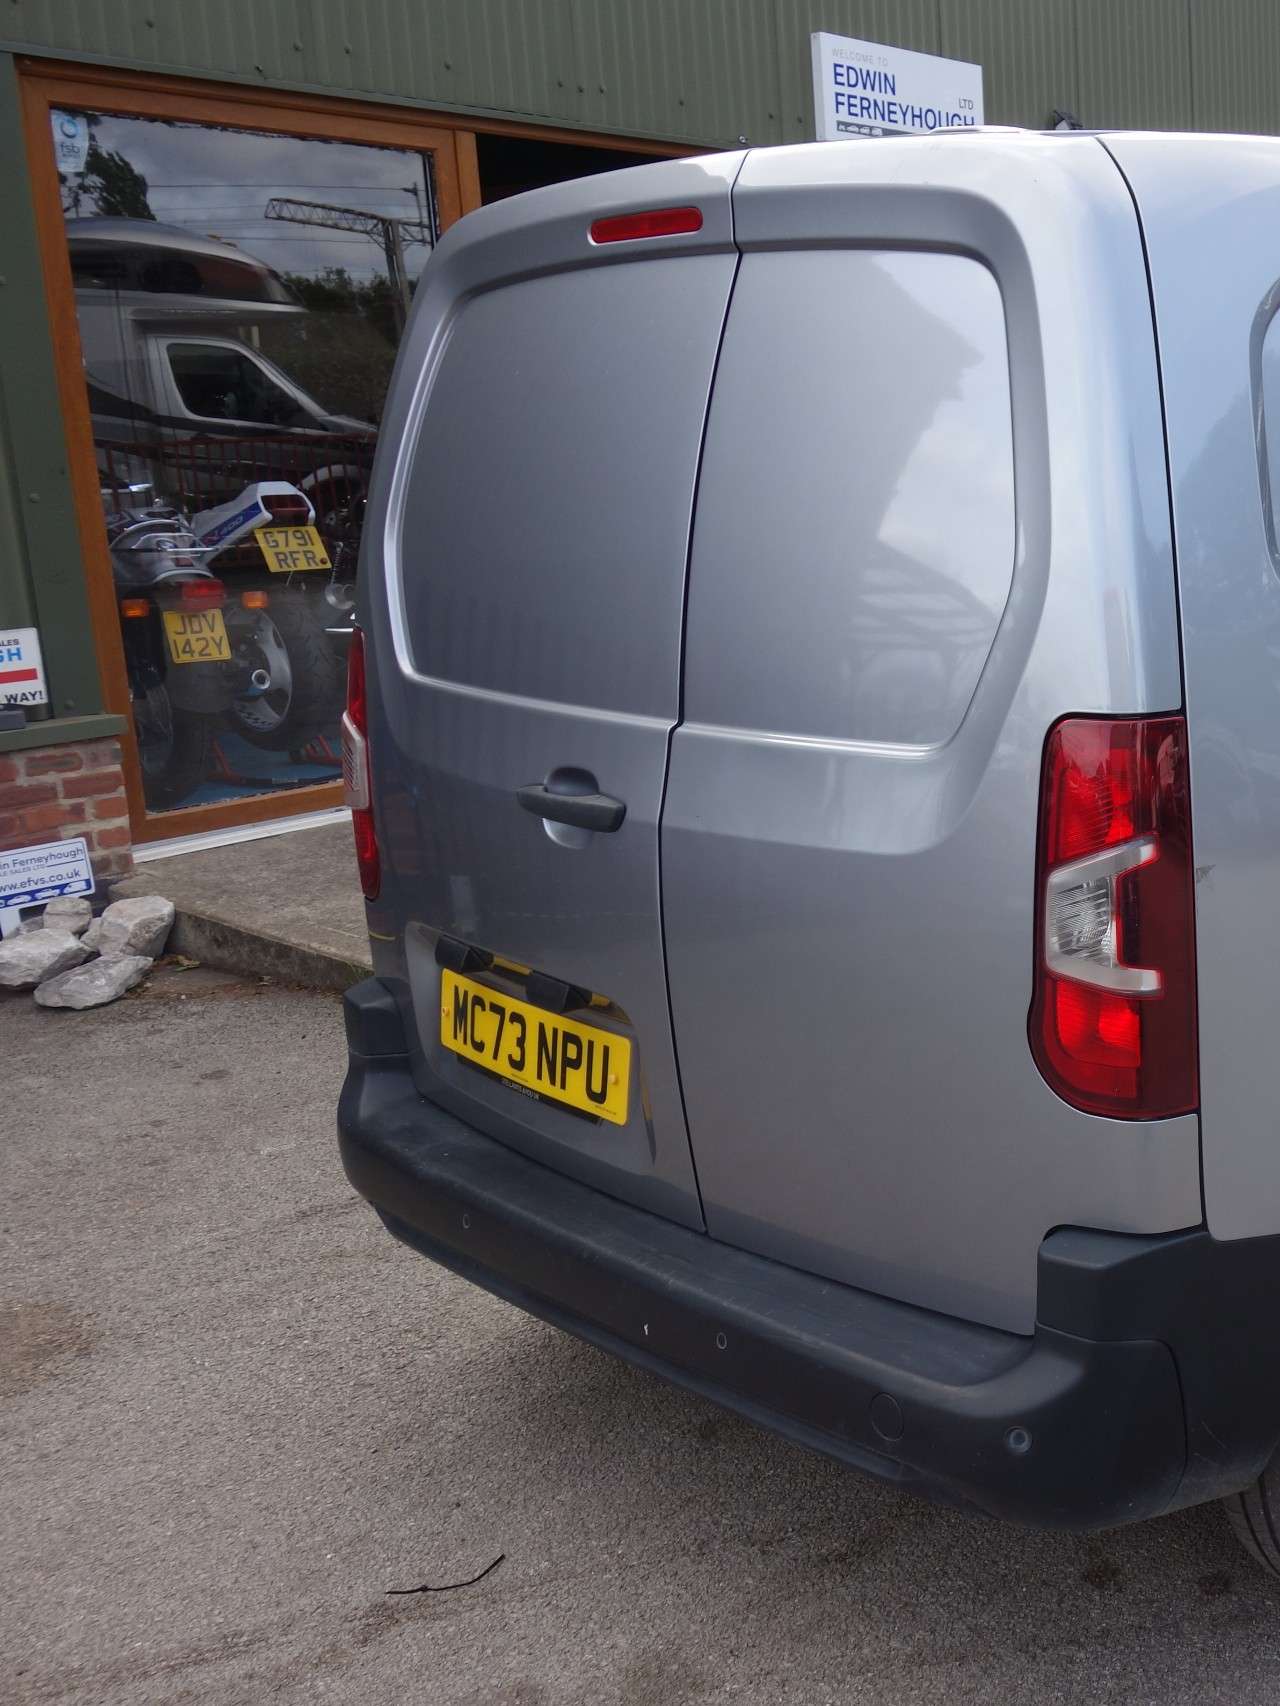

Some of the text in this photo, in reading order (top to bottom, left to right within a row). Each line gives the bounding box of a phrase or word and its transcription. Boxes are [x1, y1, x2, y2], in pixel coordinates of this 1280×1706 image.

[832, 48, 874, 64] WELCOME
[833, 62, 896, 96] EDWIN
[834, 92, 975, 130] FERNEYHOUGH
[958, 98, 974, 111] LTD
[263, 529, 315, 548] G791
[274, 549, 320, 569] RFR
[174, 613, 216, 635] JDV
[172, 636, 224, 660] 142Y
[4, 689, 43, 704] WAY!
[12, 847, 84, 867] Ferneyhough
[453, 984, 610, 1105] MC73 NPU
